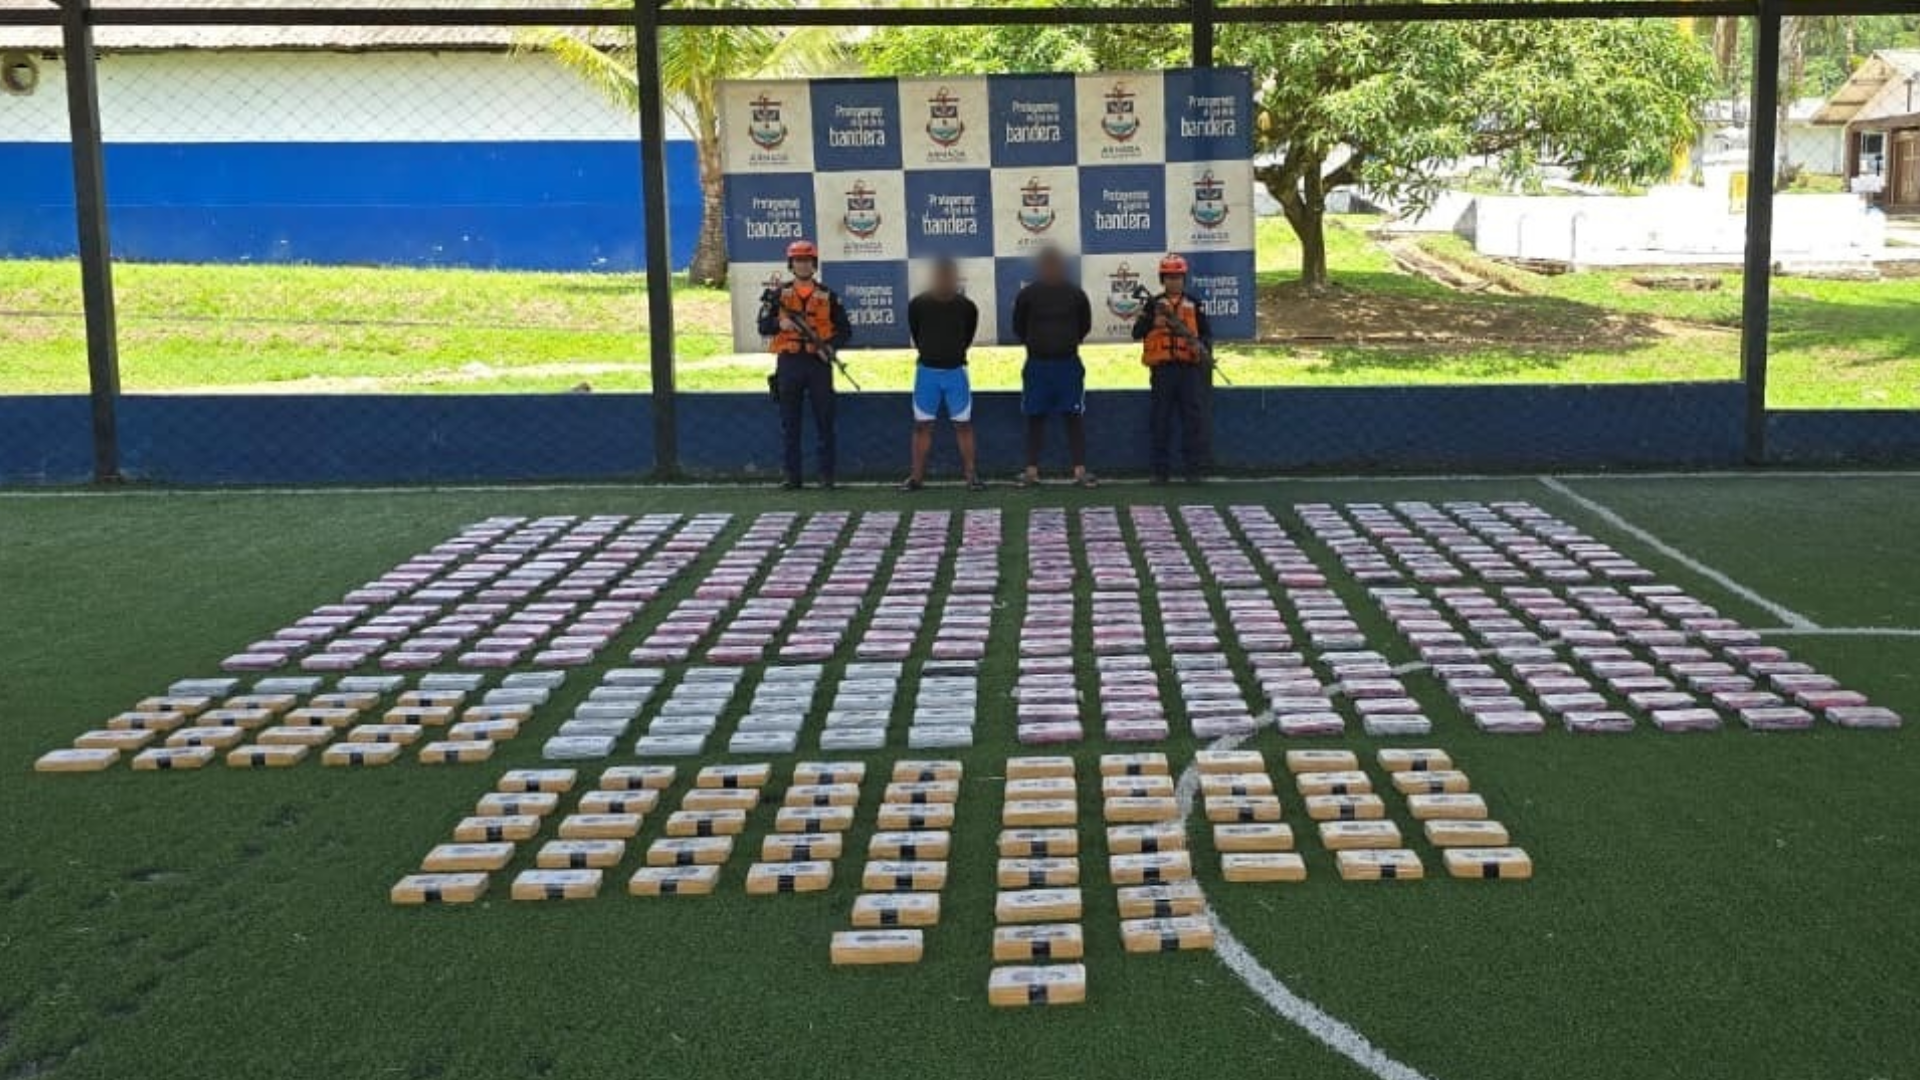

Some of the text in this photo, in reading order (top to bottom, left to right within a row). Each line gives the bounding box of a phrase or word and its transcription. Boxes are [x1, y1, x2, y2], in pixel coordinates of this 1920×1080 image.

[829, 126, 886, 147] bandera
[1006, 122, 1061, 143] bandera
[1181, 117, 1237, 138] bandera
[747, 217, 803, 239] bandera
[922, 213, 978, 235] bandera
[1095, 210, 1151, 231] bandera
[846, 305, 896, 326] andera
